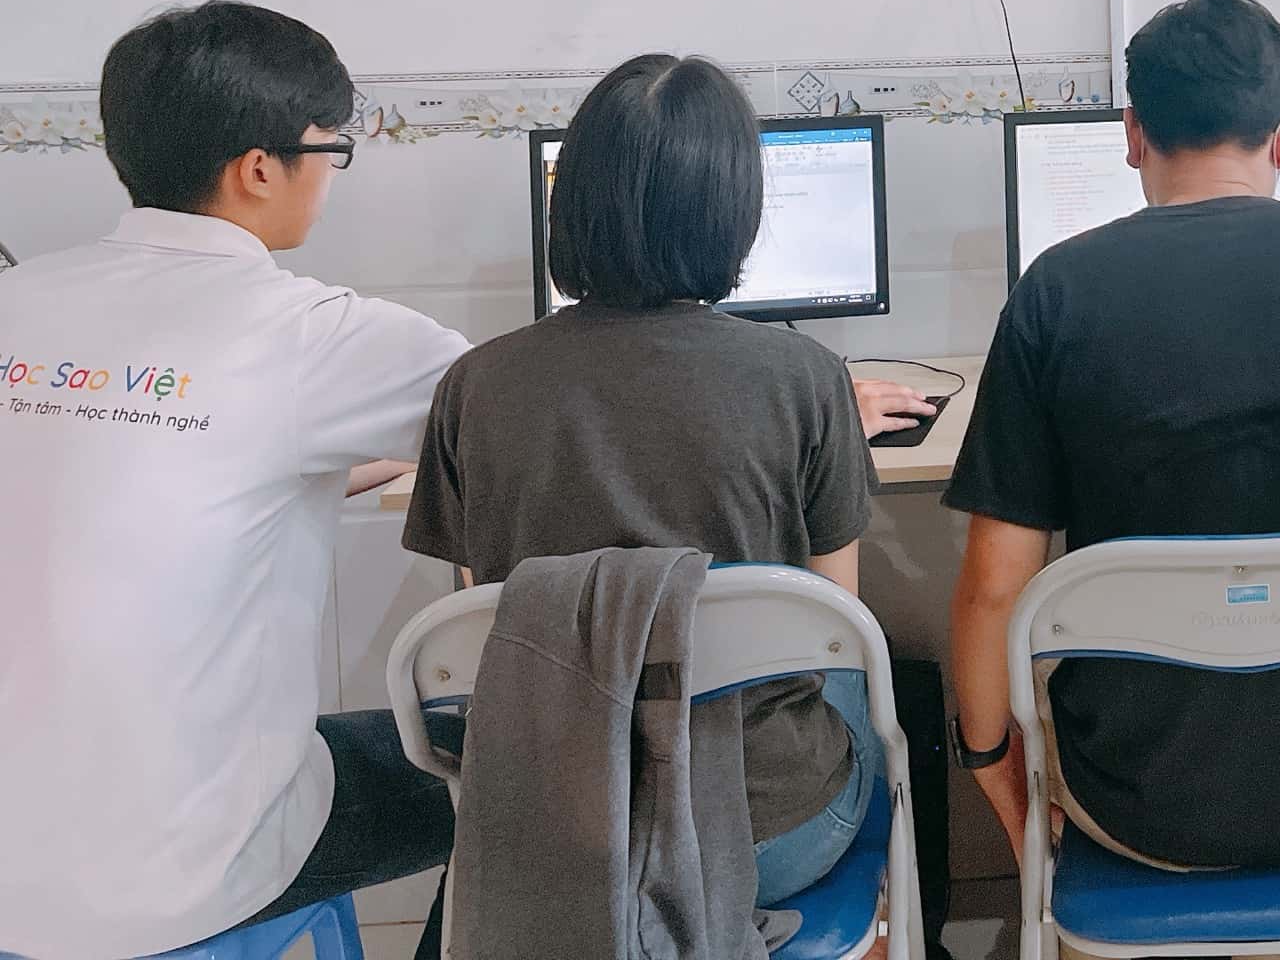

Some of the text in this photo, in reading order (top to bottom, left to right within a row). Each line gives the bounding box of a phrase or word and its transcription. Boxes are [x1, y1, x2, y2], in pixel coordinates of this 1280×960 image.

[50, 361, 111, 391] Sao
[125, 364, 193, 402] Việt
[8, 398, 32, 414] Tận
[75, 403, 108, 422] Học
[112, 407, 162, 426] thành
